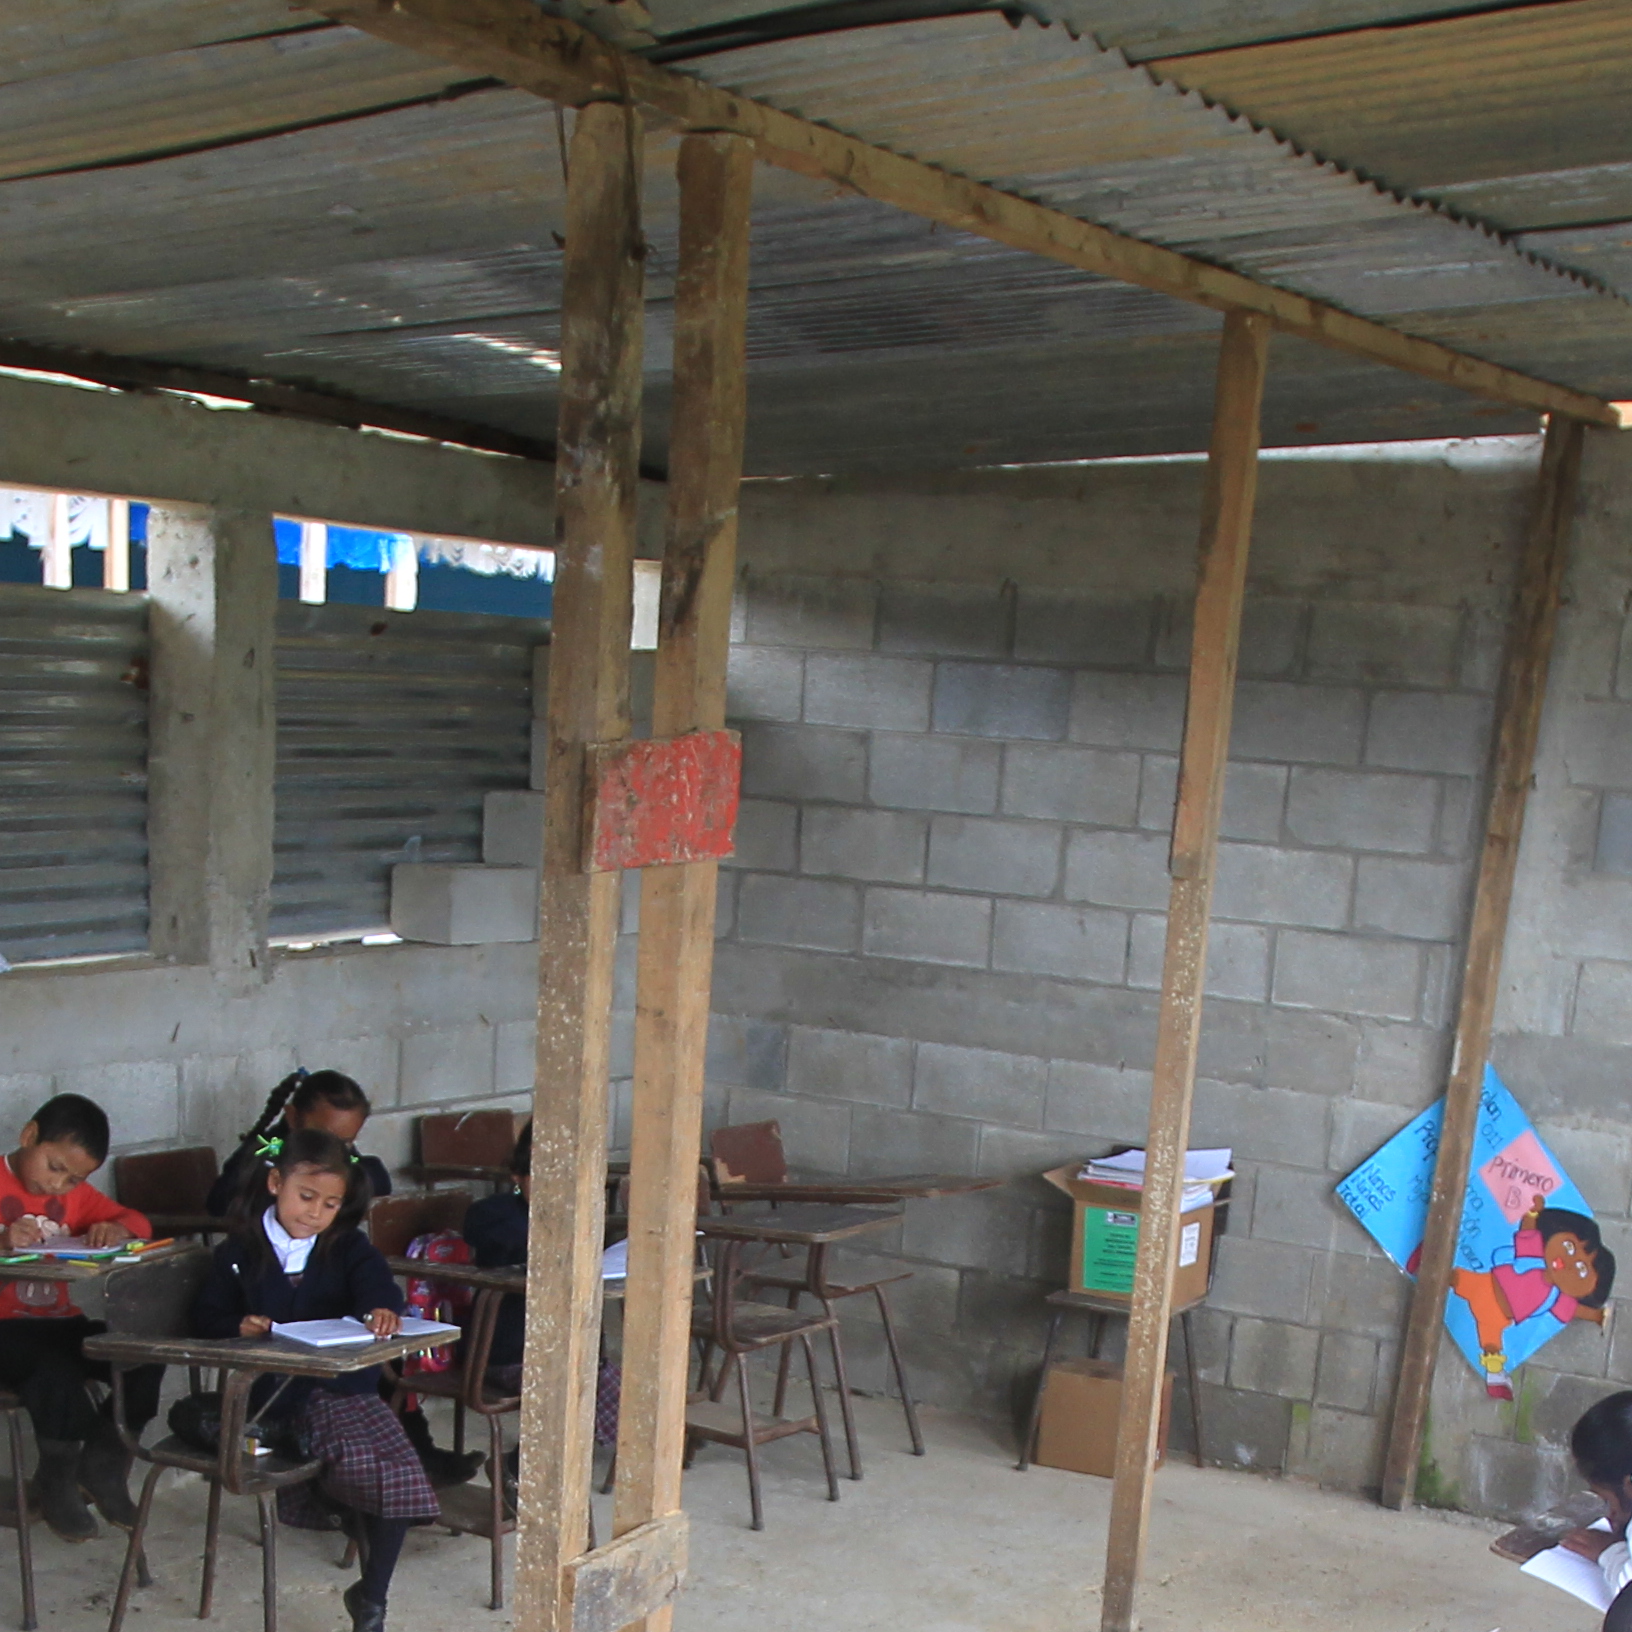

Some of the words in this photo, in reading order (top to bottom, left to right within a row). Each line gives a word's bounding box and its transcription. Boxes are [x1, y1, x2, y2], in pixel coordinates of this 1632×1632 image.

[1487, 1154, 1554, 1193] Primero
[1338, 1184, 1371, 1220] Total
[1504, 1184, 1523, 1210] B
